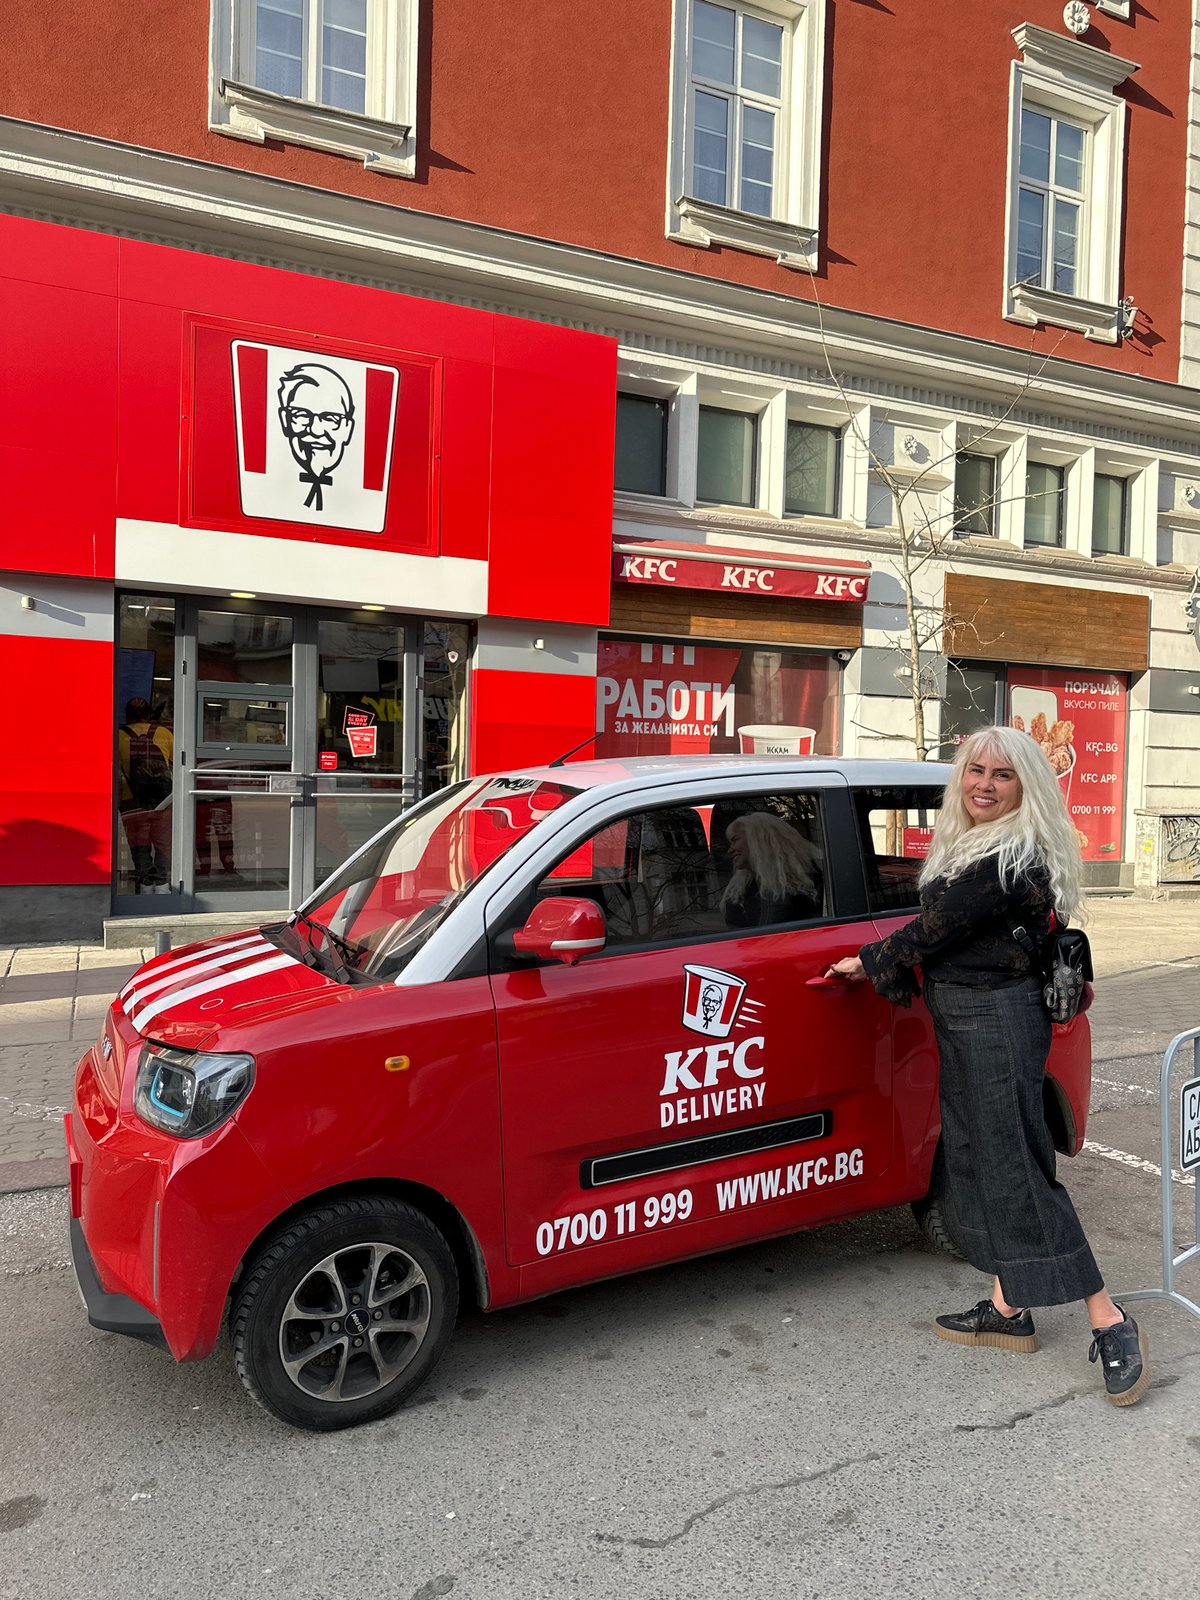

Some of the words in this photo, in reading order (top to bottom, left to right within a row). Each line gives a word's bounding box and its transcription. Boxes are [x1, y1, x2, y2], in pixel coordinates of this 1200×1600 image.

[620, 555, 678, 582] KFC
[720, 565, 775, 591] KFC
[814, 574, 866, 598] KFC
[1064, 680, 1120, 697] ПОРЪЧАЙ
[596, 676, 735, 737] РАБОТИ
[1064, 699, 1097, 710] ВКУСНО
[1098, 700, 1120, 711] ПИЛЕ
[614, 720, 629, 734] ЗА
[632, 721, 701, 736] ЖЕЛАНИЯТА
[703, 723, 718, 737] СИ
[766, 746, 789, 754] ИСКАМ
[1085, 741, 1119, 753] KFC.BG
[1080, 773, 1098, 783] KFC
[1100, 773, 1117, 783] APP
[1071, 805, 1092, 815] 0700
[1093, 805, 1100, 815] 11
[1102, 805, 1116, 815] 999
[659, 1036, 765, 1096] KFC
[660, 1082, 766, 1128] DELIVERY
[536, 1209, 607, 1256] 0700
[614, 1201, 636, 1235] 11
[643, 1189, 693, 1228] 999
[716, 1148, 864, 1211] WWW.KFC.BG
